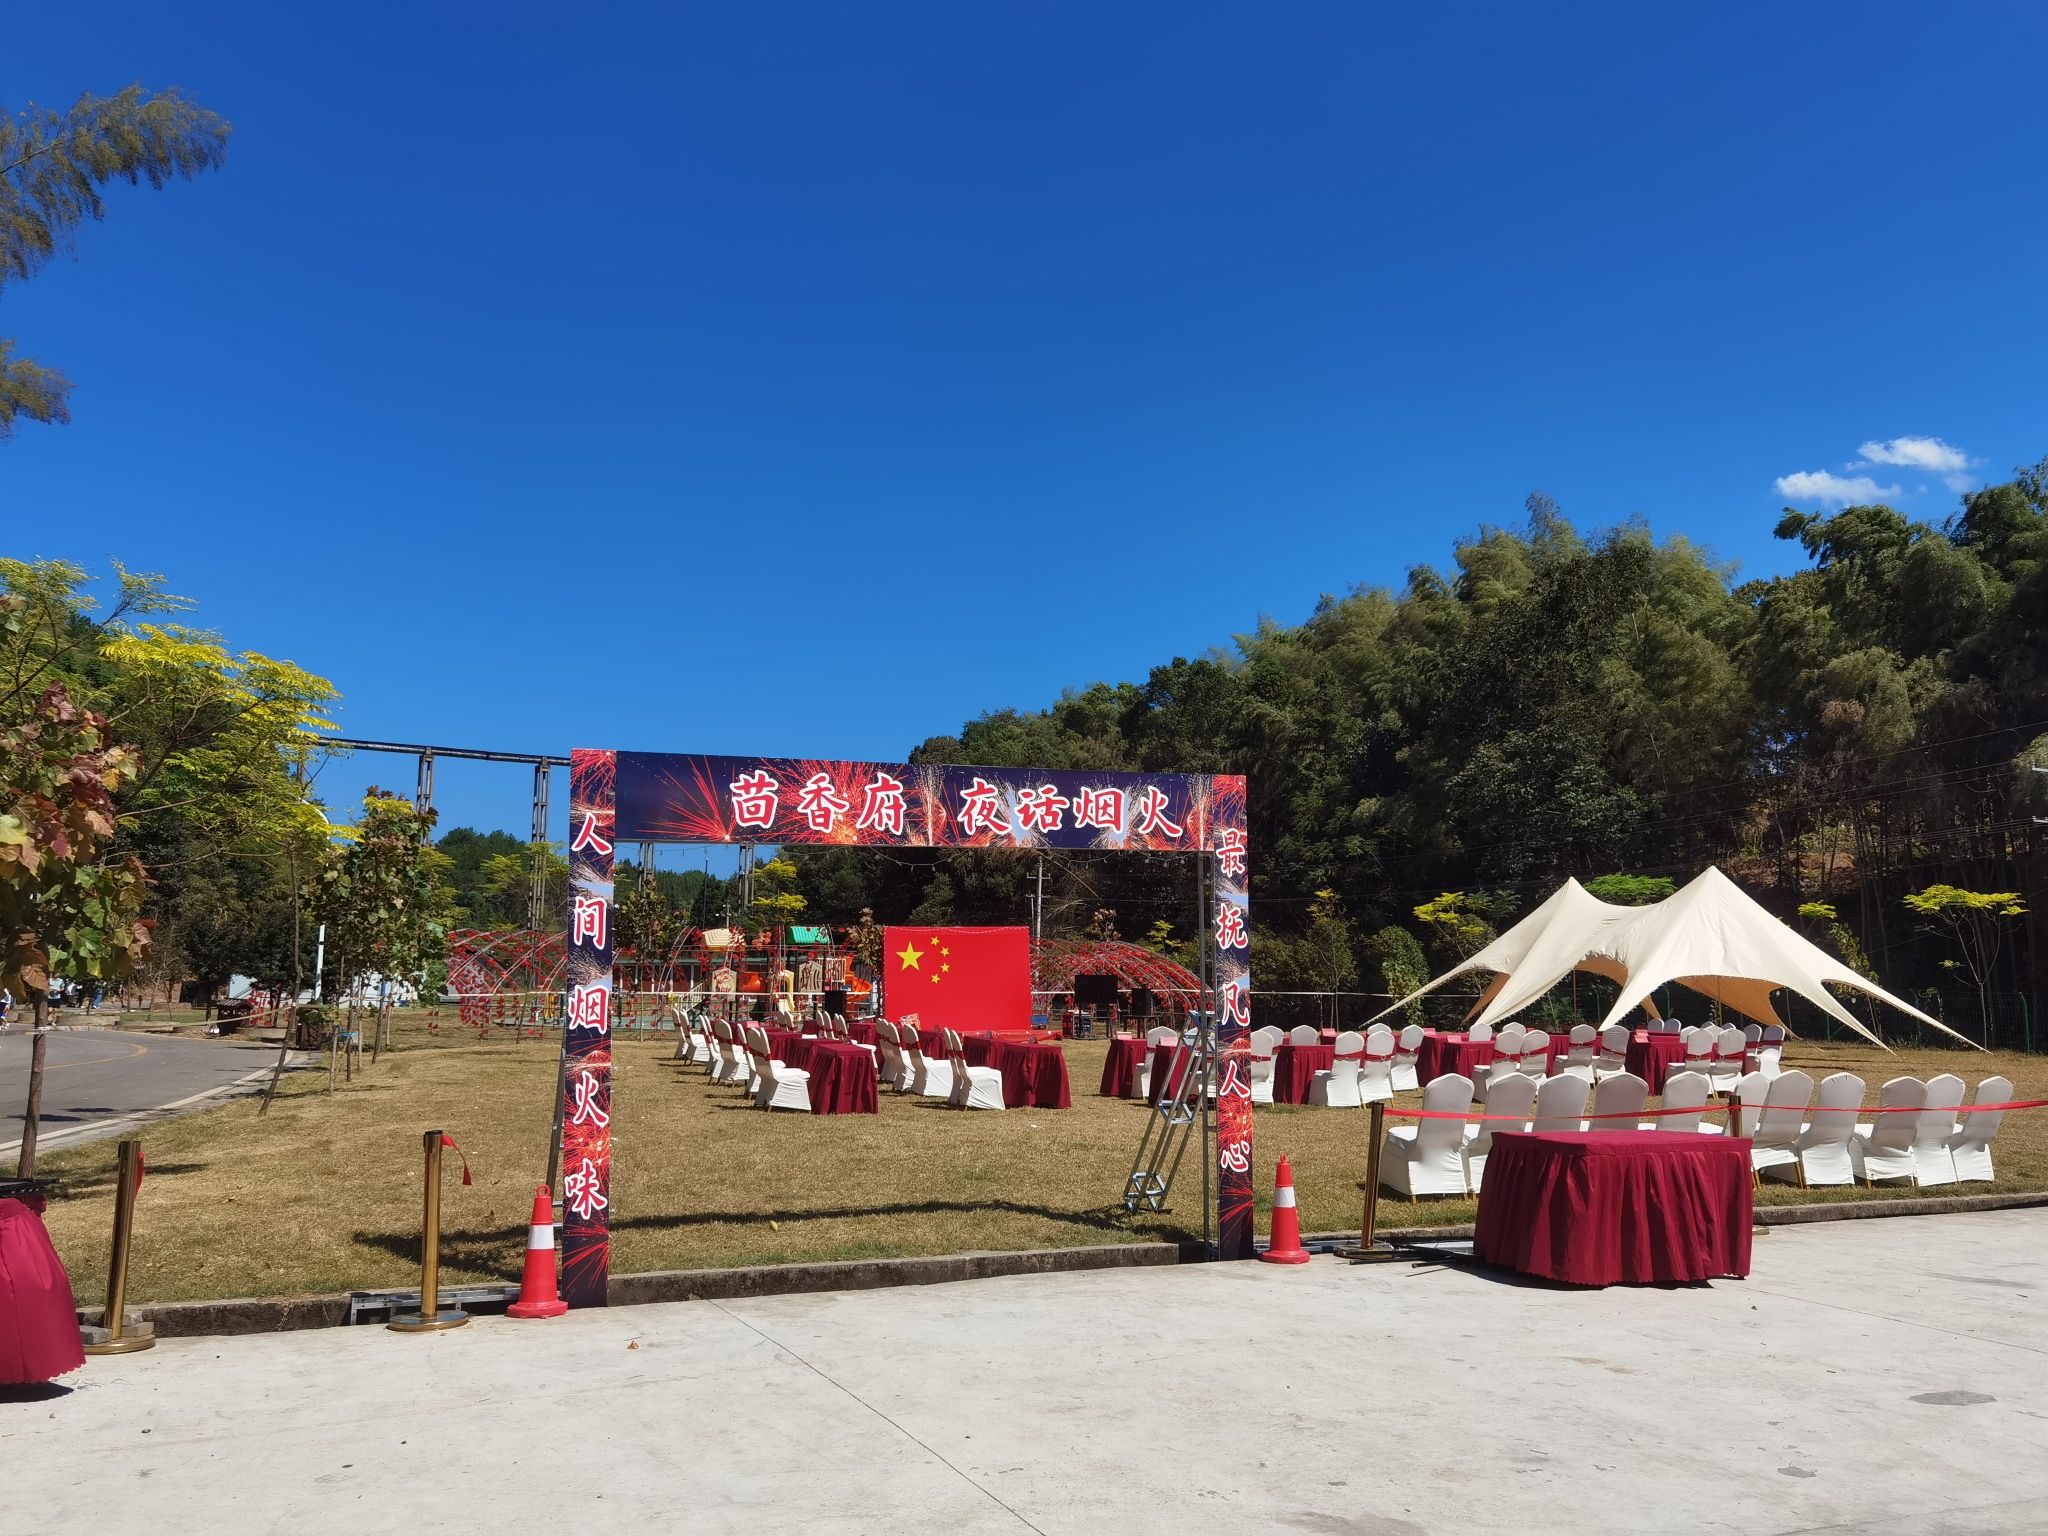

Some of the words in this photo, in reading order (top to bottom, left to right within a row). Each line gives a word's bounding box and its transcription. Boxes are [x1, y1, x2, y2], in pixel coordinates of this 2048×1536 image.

[730, 770, 907, 835] 茴香府
[958, 777, 1183, 837] 夜话烟火
[566, 813, 612, 1220] 人间烟火味
[1215, 828, 1250, 1173] 最抚凡人心
